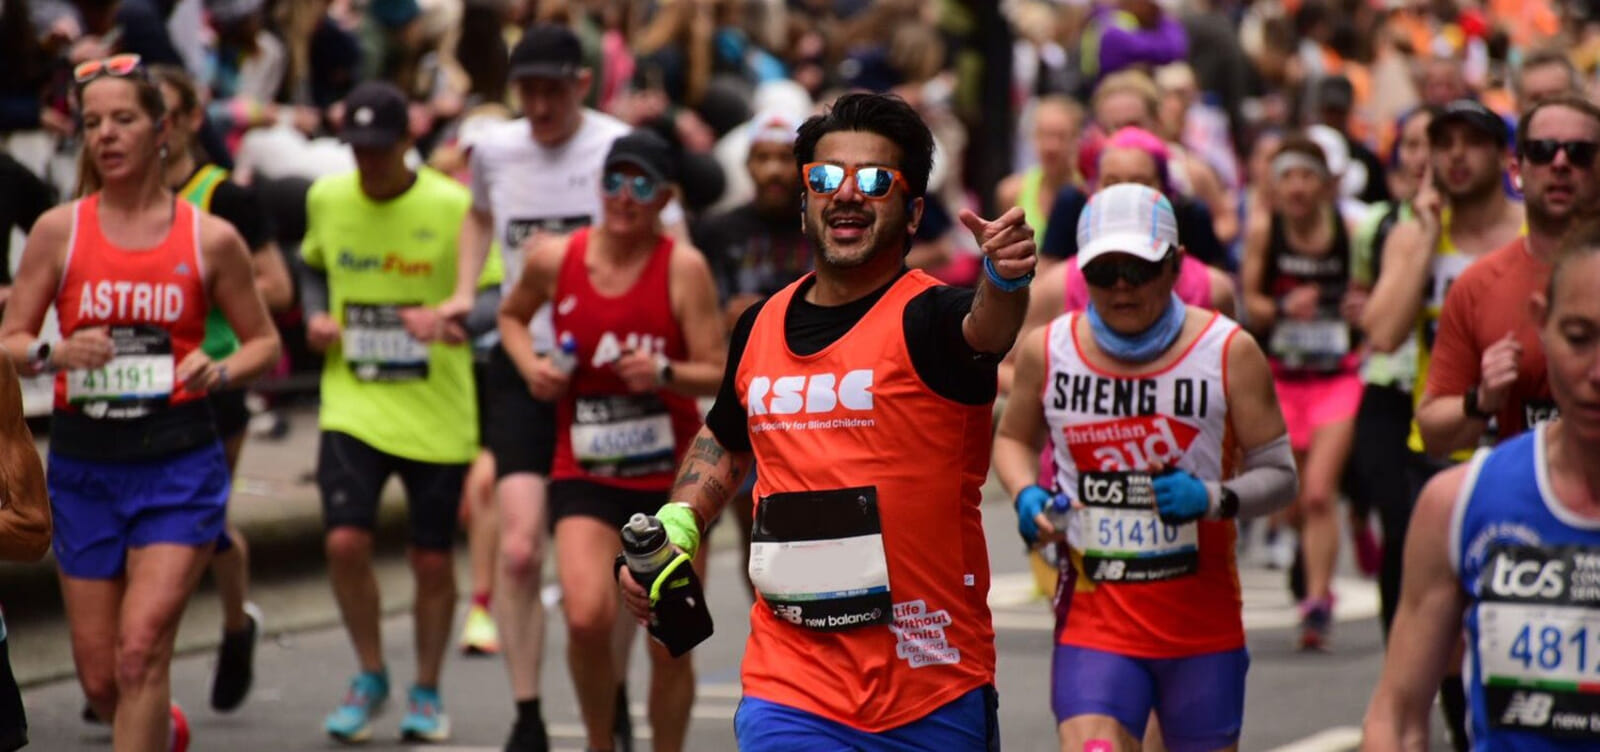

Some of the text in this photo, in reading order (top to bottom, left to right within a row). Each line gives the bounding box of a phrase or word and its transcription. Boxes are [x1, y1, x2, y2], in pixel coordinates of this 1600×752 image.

[78, 280, 184, 322] ASTRID
[747, 369, 875, 417] RSBC
[1054, 372, 1208, 418] SHENG QI
[793, 419, 806, 430] for
[808, 418, 831, 430] Blind
[832, 417, 875, 428] Children
[1083, 475, 1123, 504] tcs
[1098, 517, 1178, 546] 51410
[1492, 551, 1566, 599] tcs
[805, 617, 826, 628] new
[894, 603, 920, 618] Life
[1508, 623, 1600, 674] 481
[1553, 715, 1589, 731] new
